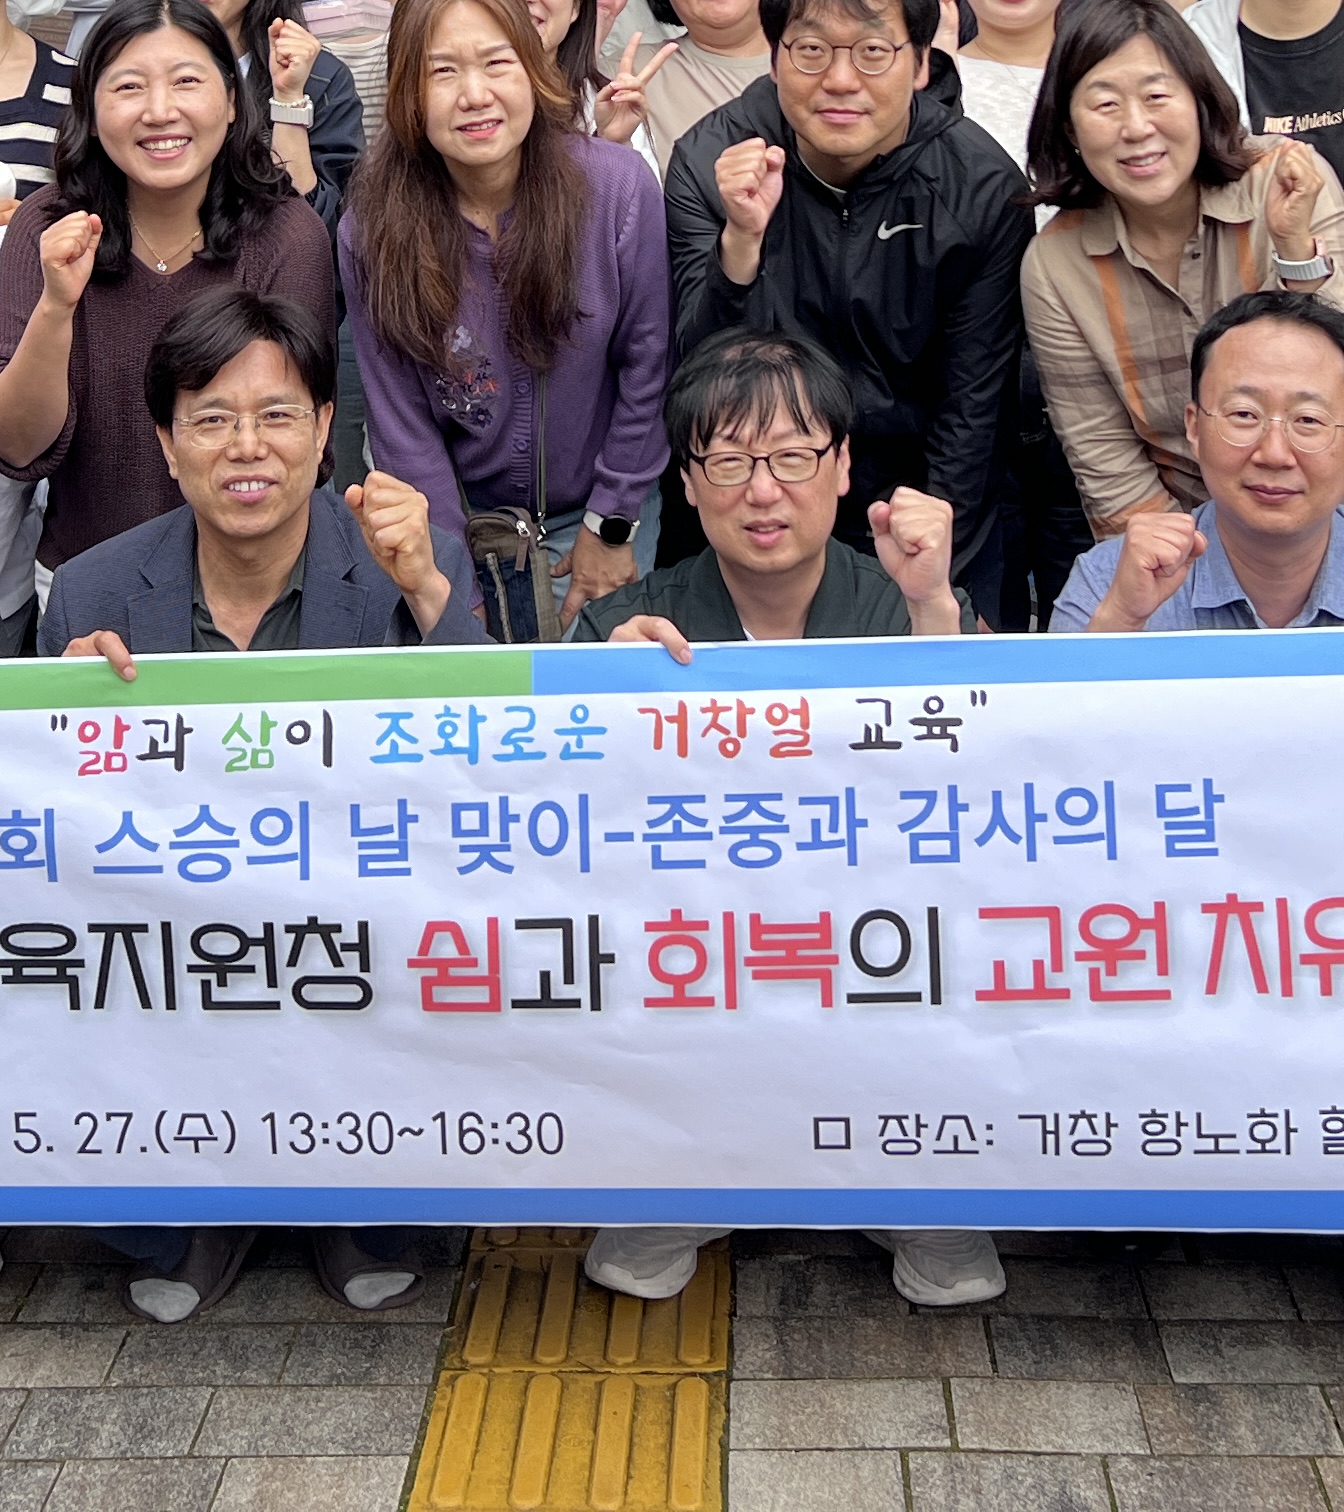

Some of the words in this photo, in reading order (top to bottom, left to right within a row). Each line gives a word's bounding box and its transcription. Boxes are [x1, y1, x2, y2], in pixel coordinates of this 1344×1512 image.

[1263, 115, 1294, 134] NIKE
[1294, 110, 1343, 133] Athletics
[51, 710, 194, 776] "앎과
[222, 709, 333, 772] 삶이
[369, 704, 607, 764] 조화로운
[637, 697, 813, 759] 거창얼
[849, 689, 987, 753] 교육"
[93, 801, 309, 882] 스승의
[350, 799, 418, 877] 날
[898, 781, 1117, 863] 감사의
[1156, 778, 1224, 857] 달
[407, 915, 615, 1013] 쉼과
[644, 907, 942, 1009] 회복의
[976, 902, 1171, 1002] 교원
[14, 1112, 53, 1153] 5.
[75, 1110, 236, 1154] 27.(수)
[261, 1112, 563, 1155] 13:30~16:30
[878, 1114, 993, 1155] 장소:
[1018, 1110, 1118, 1156] 거창
[1139, 1108, 1298, 1156] 항노화
